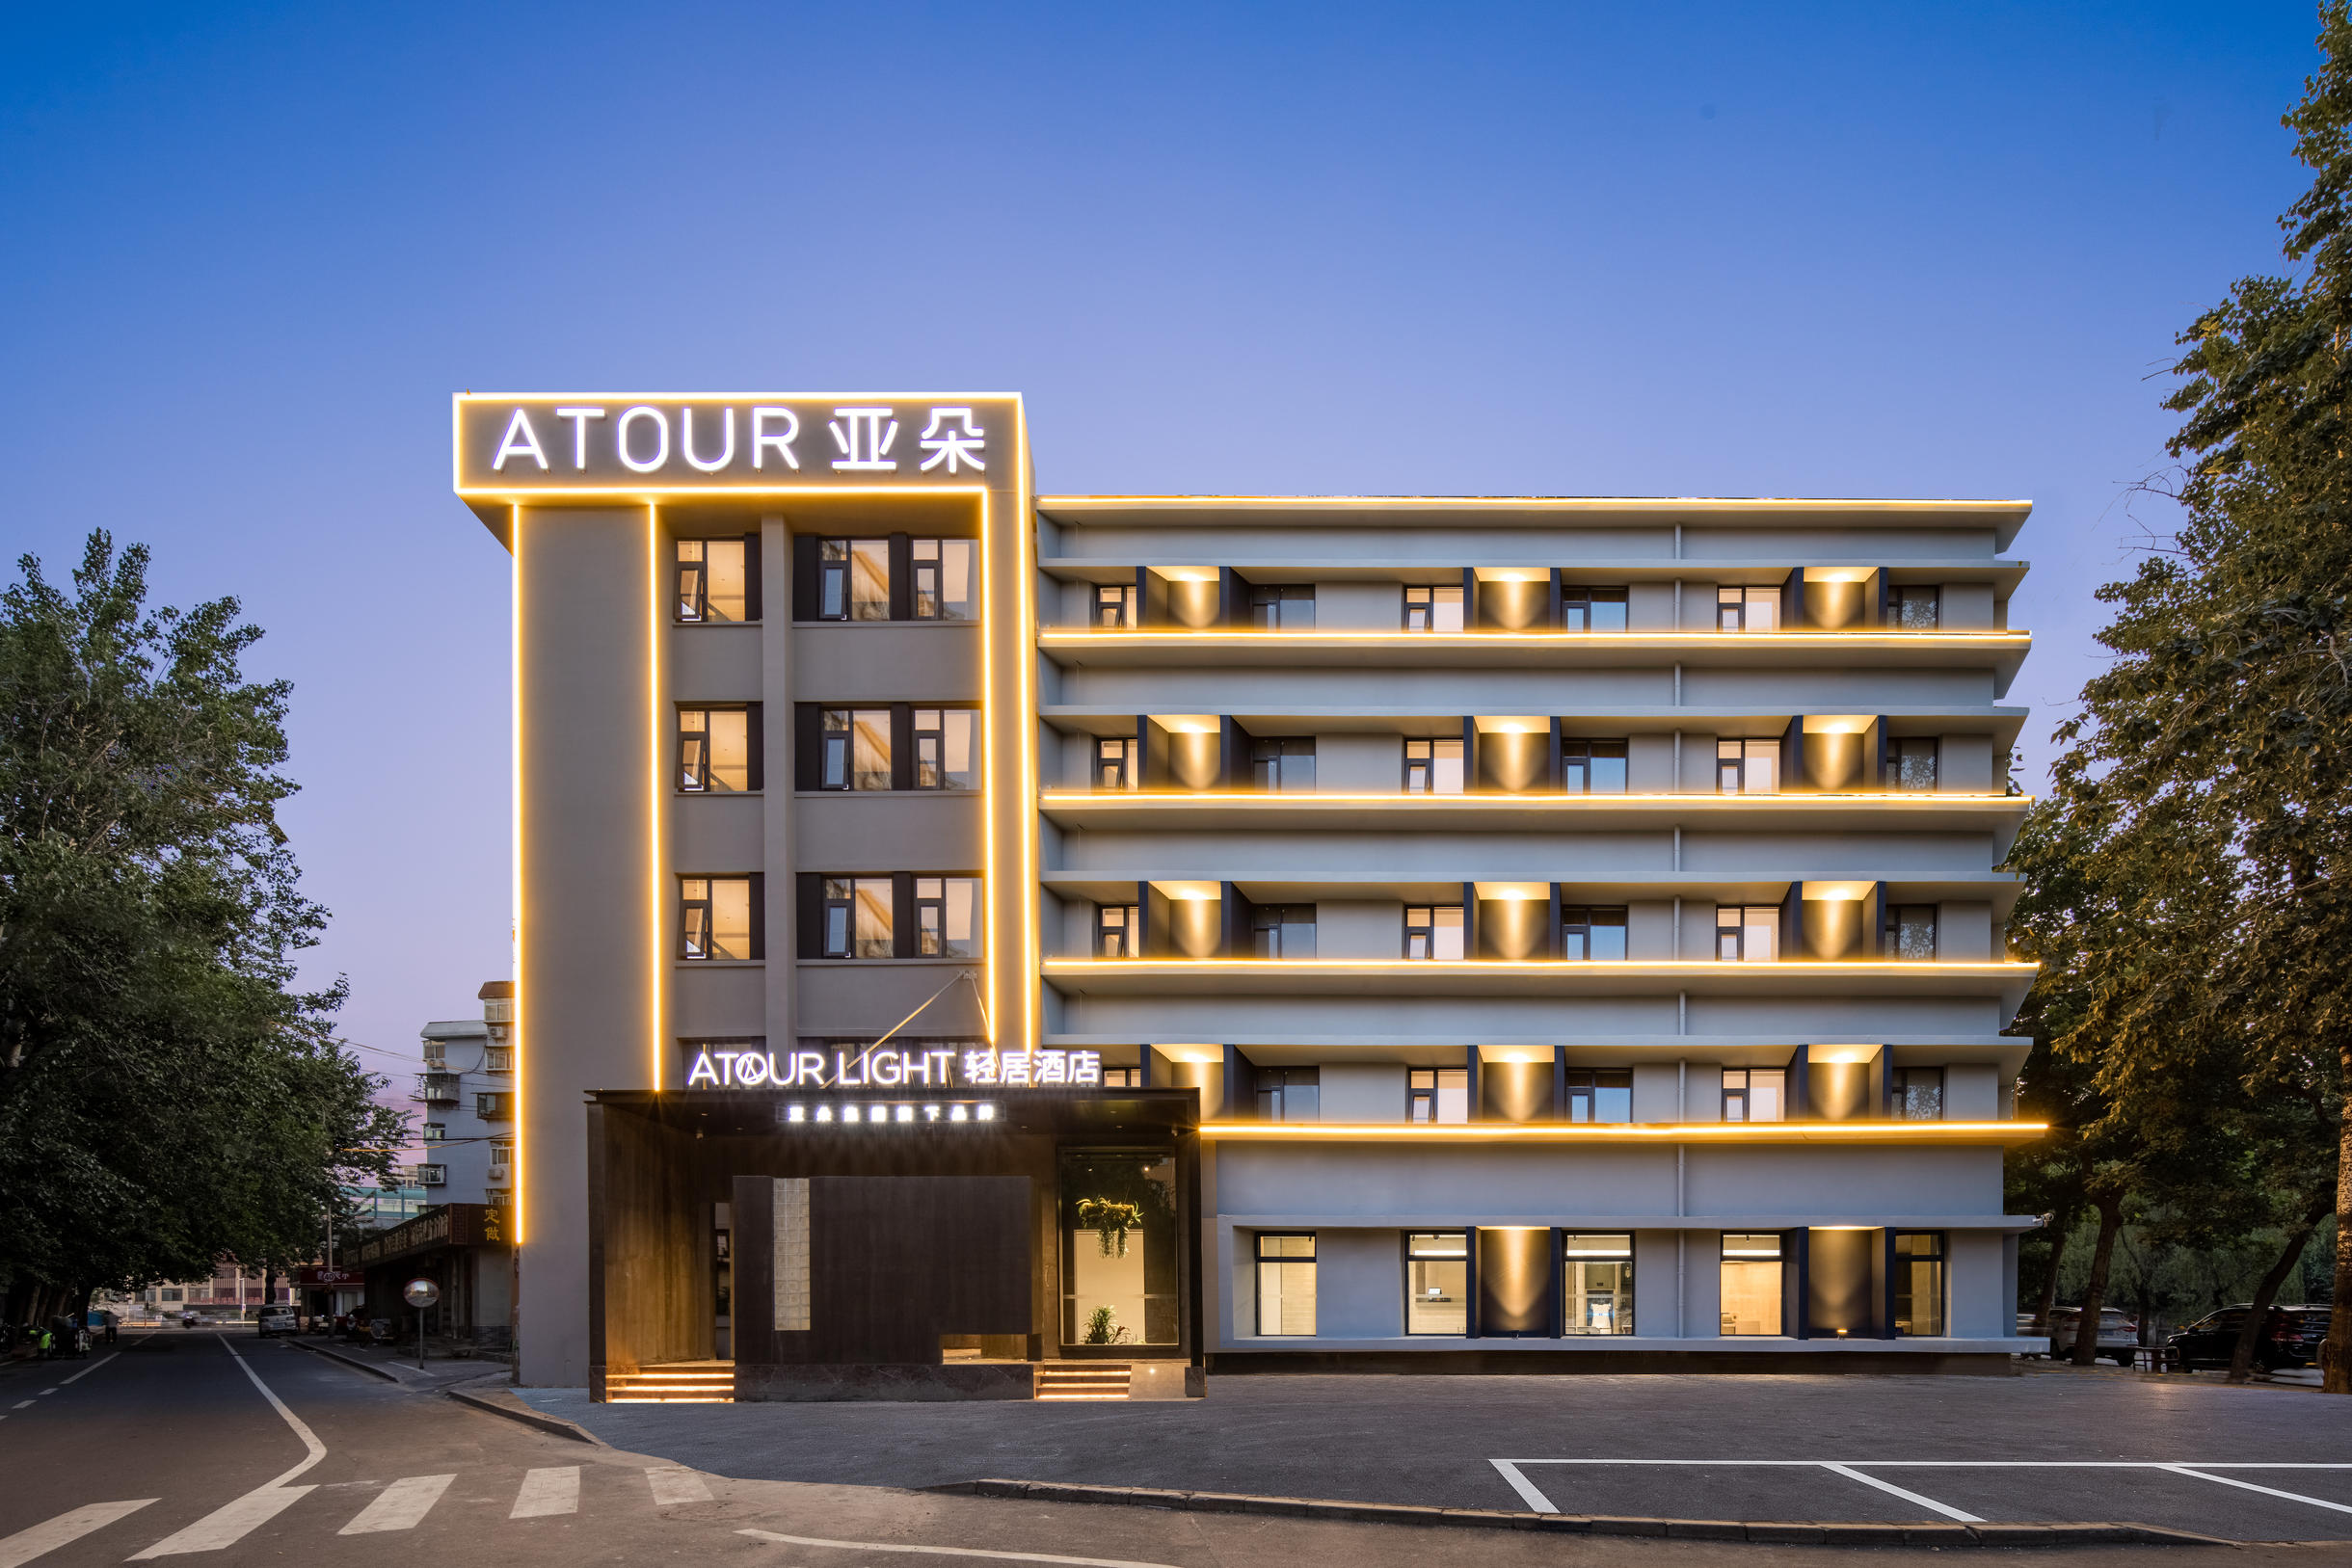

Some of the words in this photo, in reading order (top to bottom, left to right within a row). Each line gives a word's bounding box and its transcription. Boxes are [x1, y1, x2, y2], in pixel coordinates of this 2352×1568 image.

[493, 406, 799, 472] ATOUR
[829, 407, 985, 473] 亚朵
[688, 1052, 825, 1085] ATOUR
[838, 1051, 955, 1085] LIGHT
[964, 1049, 1100, 1084] 轻居酒店
